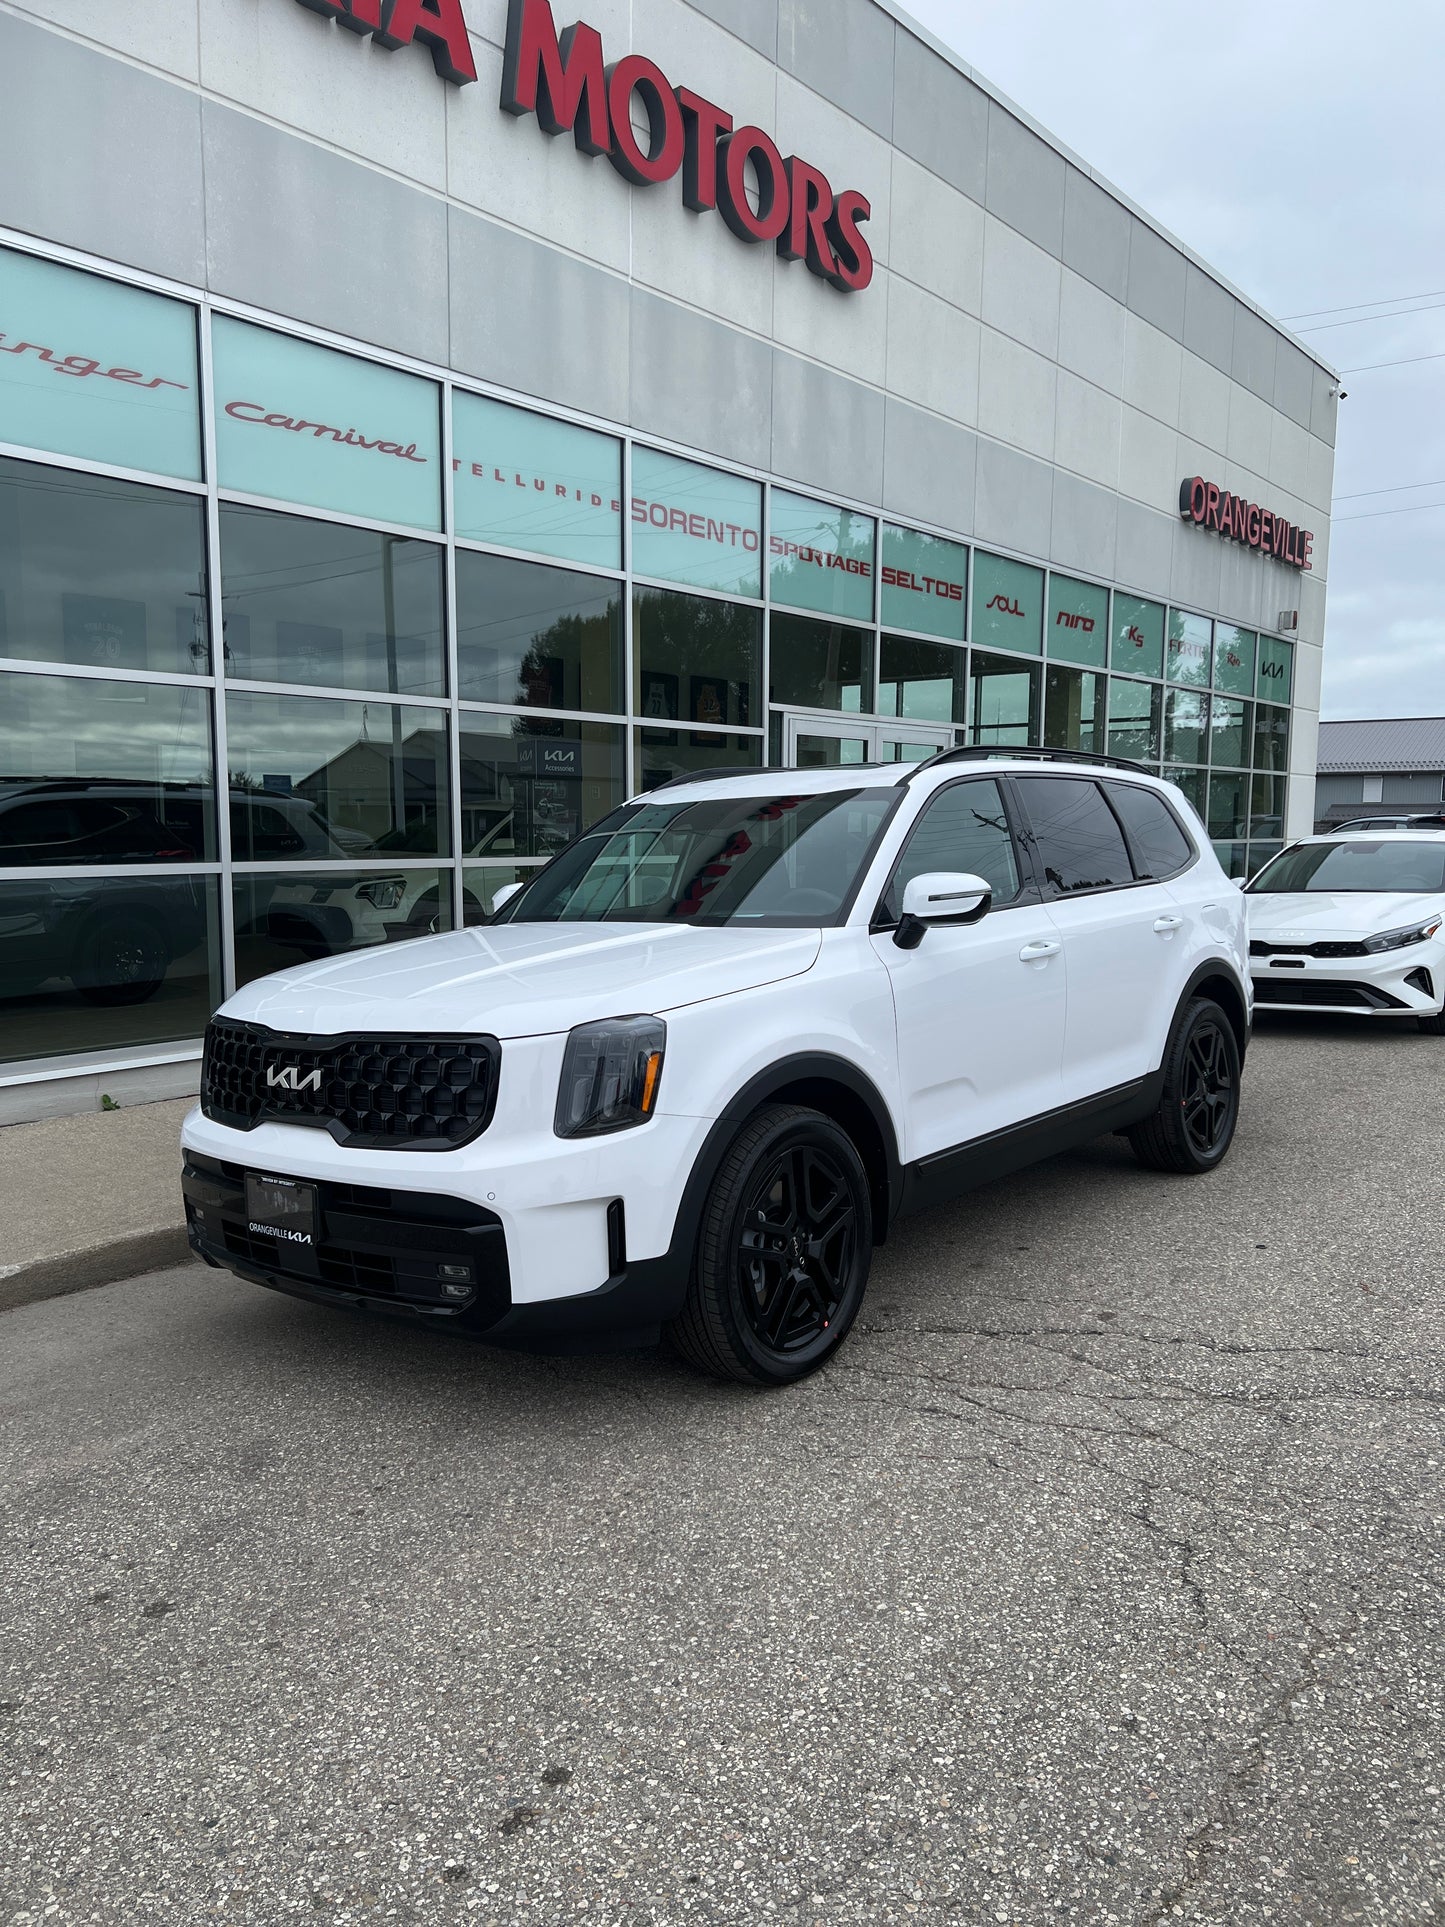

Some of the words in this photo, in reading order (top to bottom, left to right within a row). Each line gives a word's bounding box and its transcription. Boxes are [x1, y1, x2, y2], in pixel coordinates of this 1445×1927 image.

[500, 0, 872, 292] MOTORS
[0, 333, 190, 389] nger
[225, 402, 427, 462] Carnival
[453, 459, 620, 512] TELLURIDE
[631, 497, 758, 551] SORENTO
[1179, 476, 1313, 570] ORANGEVILLE
[770, 536, 871, 577] SPORTAGE
[881, 567, 963, 600] SELTOS
[1262, 661, 1284, 679] KIA
[545, 750, 575, 762] KIA
[545, 764, 575, 772] Accessories
[267, 1064, 322, 1092] KIA
[249, 1222, 288, 1239] ORANGEVILLE
[288, 1231, 312, 1244] KIA
